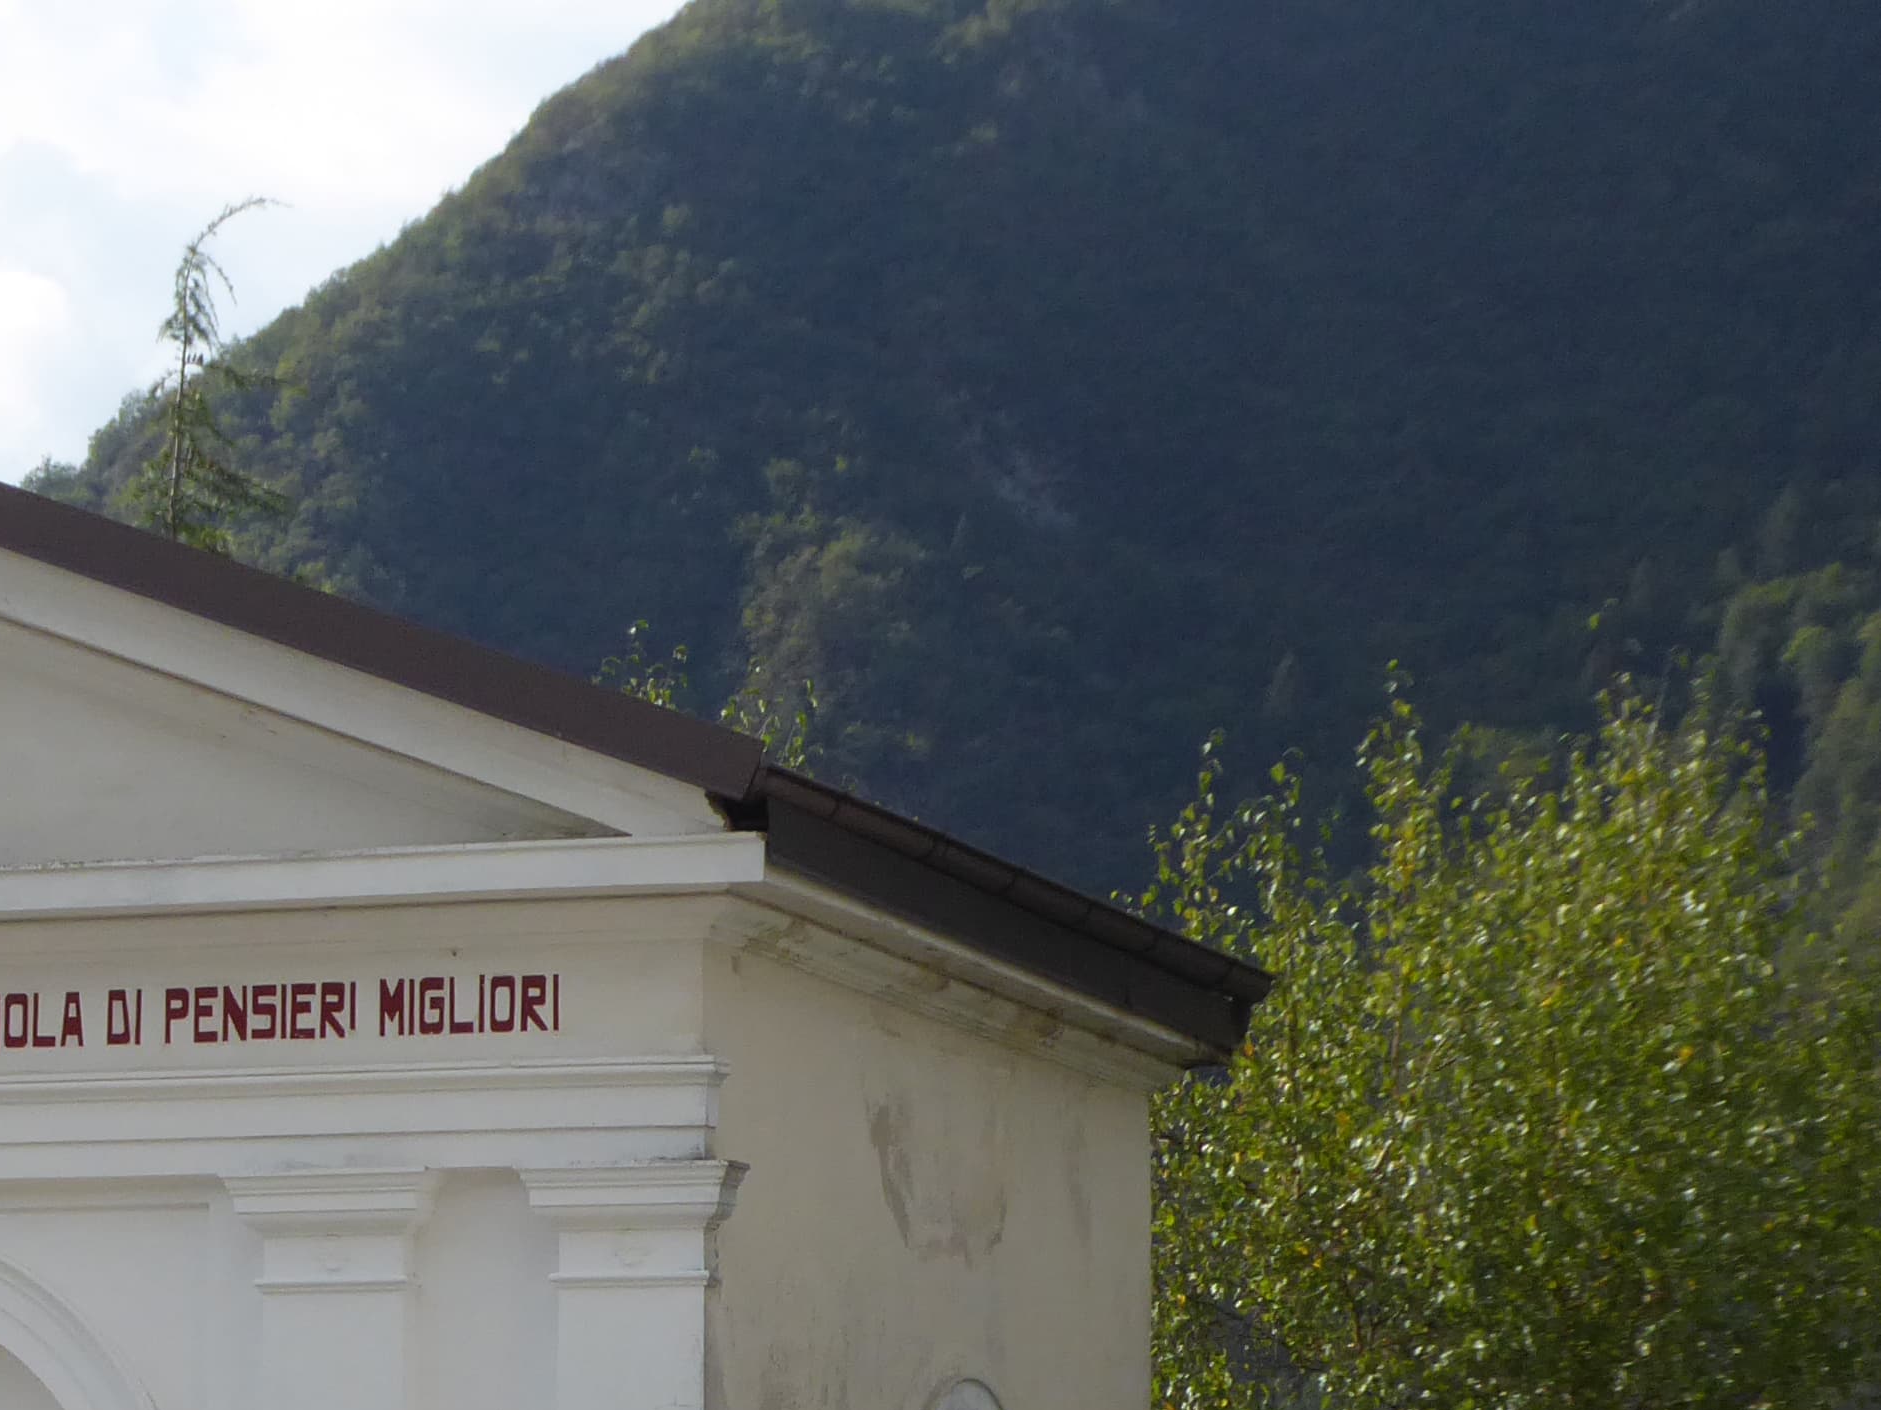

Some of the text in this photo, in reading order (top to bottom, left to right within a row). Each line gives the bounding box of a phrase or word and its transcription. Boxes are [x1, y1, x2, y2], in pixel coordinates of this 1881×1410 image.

[107, 989, 142, 1046] DI
[165, 981, 358, 1045] PENSIERI
[380, 974, 560, 1037] MIGLIORI
